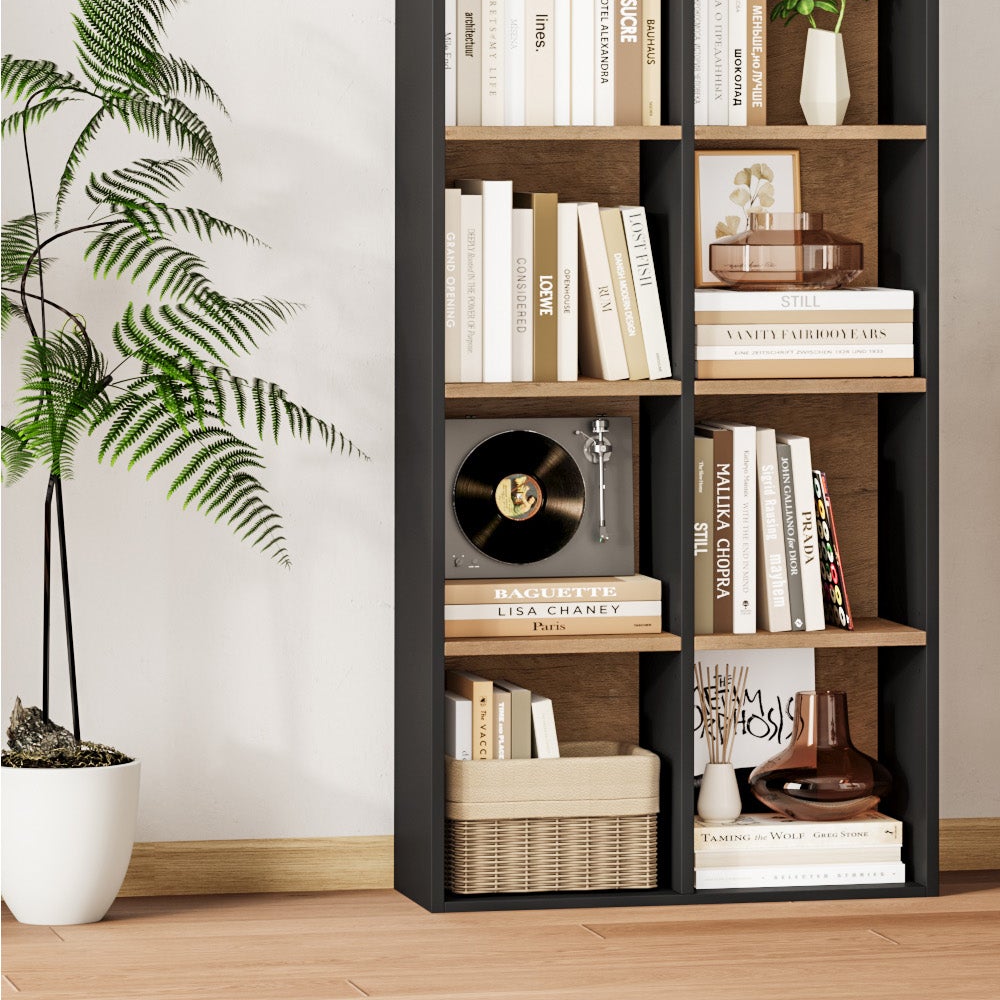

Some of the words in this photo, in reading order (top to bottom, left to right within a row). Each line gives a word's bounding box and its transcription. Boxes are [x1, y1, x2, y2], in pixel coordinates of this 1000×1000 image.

[535, 13, 548, 52] lines.
[714, 12, 723, 22] О
[465, 12, 475, 58] architectuur
[489, 41, 497, 59] MY
[646, 19, 655, 65] BAUHAUS
[600, 24, 609, 84] ALEXANDRA
[713, 24, 723, 101] ПРЕДАННЫХ
[489, 68, 497, 97] LIFE
[732, 48, 742, 107] ШОКОЛАД
[751, 70, 763, 108] ЛУЧШЕ
[467, 228, 475, 251] DEEPLY
[630, 213, 646, 251] LOST
[446, 232, 456, 272] GRAND
[614, 253, 625, 280] DANISH
[636, 255, 651, 287] FISH
[446, 276, 456, 328] OPENING
[467, 282, 475, 294] THE
[516, 257, 527, 334] CONSIDERED
[539, 275, 553, 316] LOEWE
[563, 269, 571, 314] OPENHOUSE
[599, 285, 612, 312] RUM
[619, 280, 631, 311] MODERN
[781, 295, 820, 308] STILL
[467, 296, 475, 319] POWER
[625, 311, 636, 337] DESIGN
[467, 320, 475, 329] OF
[762, 464, 774, 496] Sigrid
[716, 463, 730, 531] MALLIKA
[766, 499, 777, 540] Rausing
[694, 522, 708, 557] STILL
[803, 511, 813, 565] PRADA
[716, 538, 730, 599] CHOPRA
[742, 561, 749, 569] IN
[772, 554, 783, 608] mayhem
[493, 586, 617, 600] BAGUETTE
[498, 606, 537, 617] LISA
[547, 604, 621, 616] CHANEY
[533, 621, 566, 631] Paris
[701, 833, 751, 842] TAMING
[770, 831, 805, 840] WOLF
[840, 830, 869, 838] STONE
